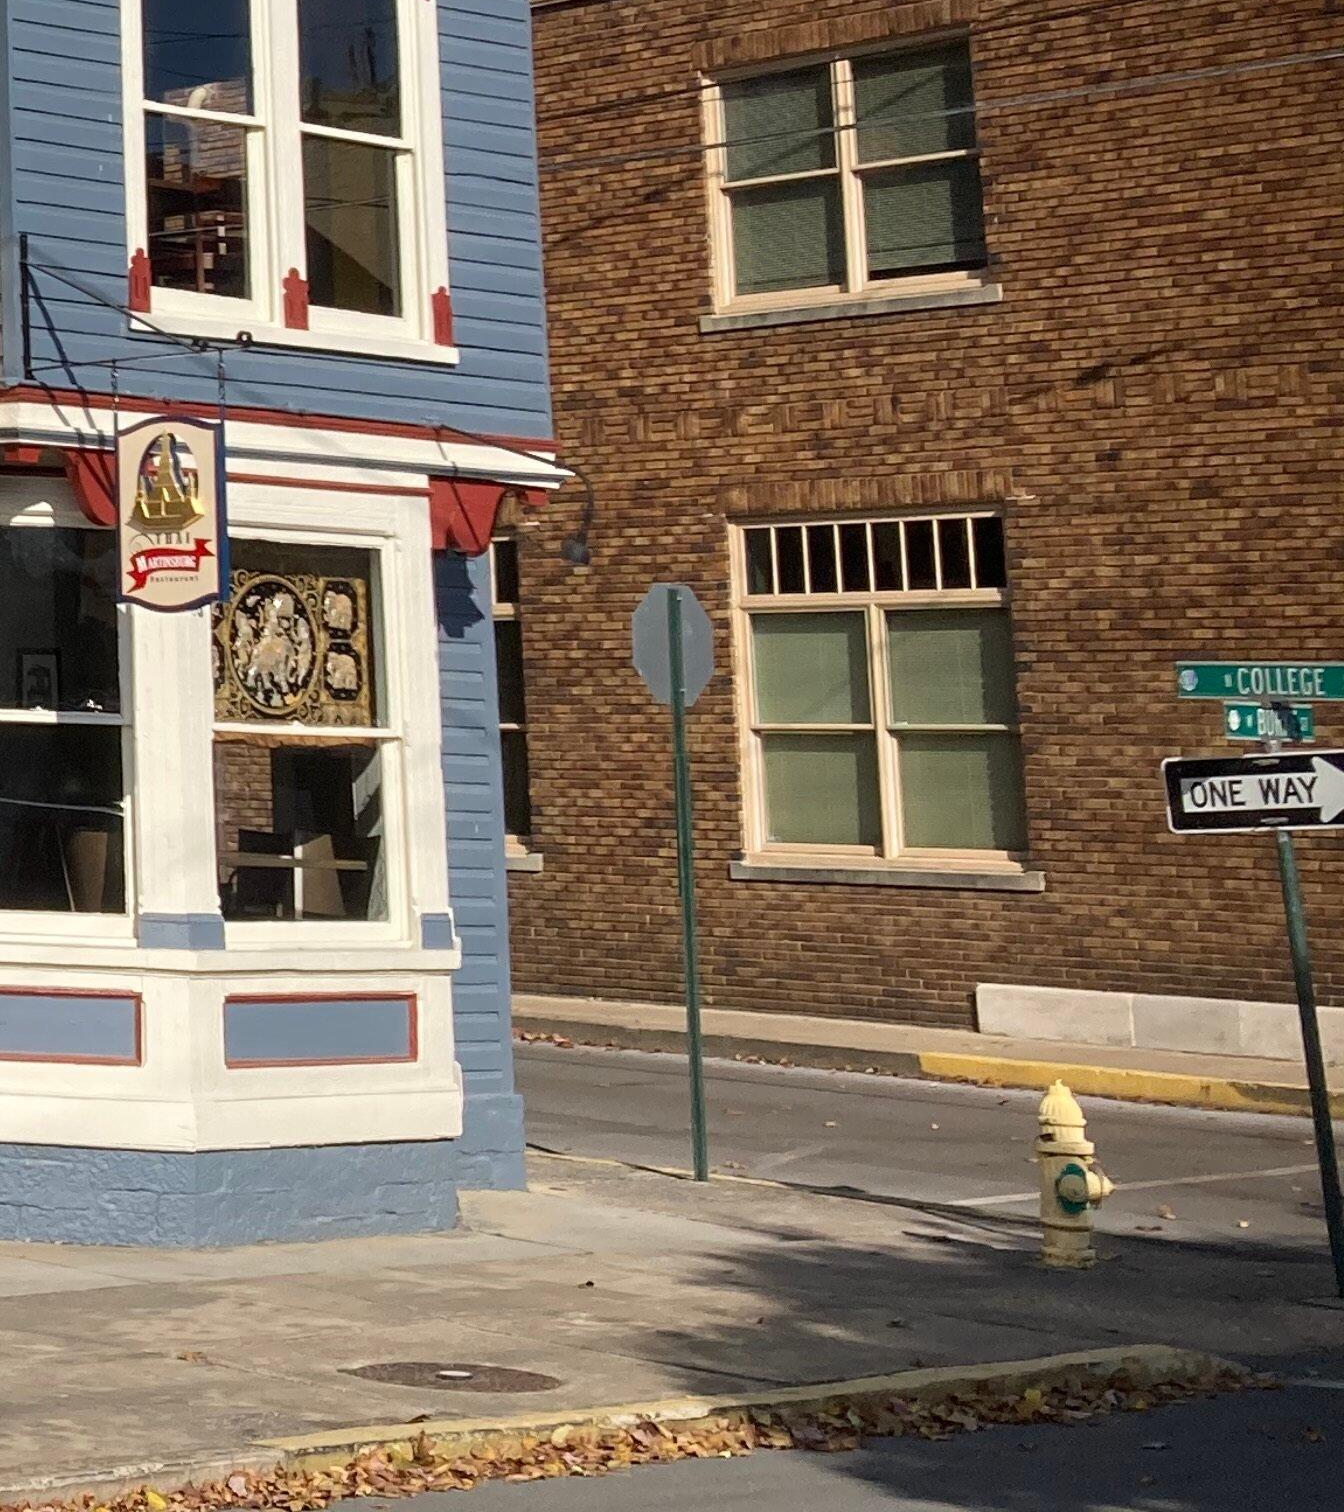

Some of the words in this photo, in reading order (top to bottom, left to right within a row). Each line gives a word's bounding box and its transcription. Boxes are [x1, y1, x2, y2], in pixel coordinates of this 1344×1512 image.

[155, 532, 191, 545] THAI
[1237, 667, 1326, 695] COLLEGE
[1190, 779, 1246, 808] ONE
[1258, 776, 1319, 805] WAY
